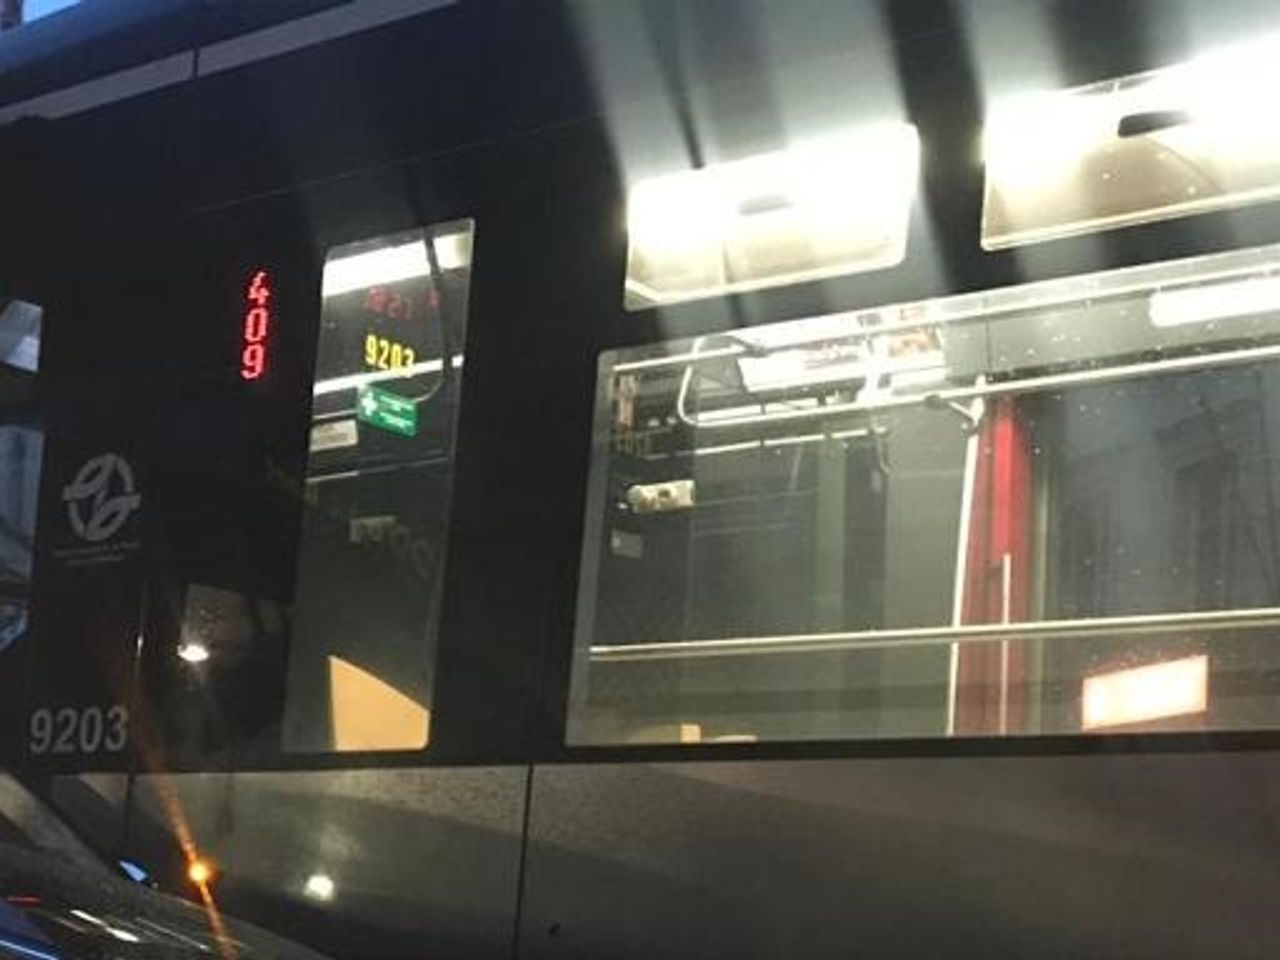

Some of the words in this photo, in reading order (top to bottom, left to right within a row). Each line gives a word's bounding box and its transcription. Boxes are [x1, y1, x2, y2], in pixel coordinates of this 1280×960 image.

[240, 270, 271, 380] 409
[365, 334, 415, 378] 9203
[30, 705, 128, 753] 9203
